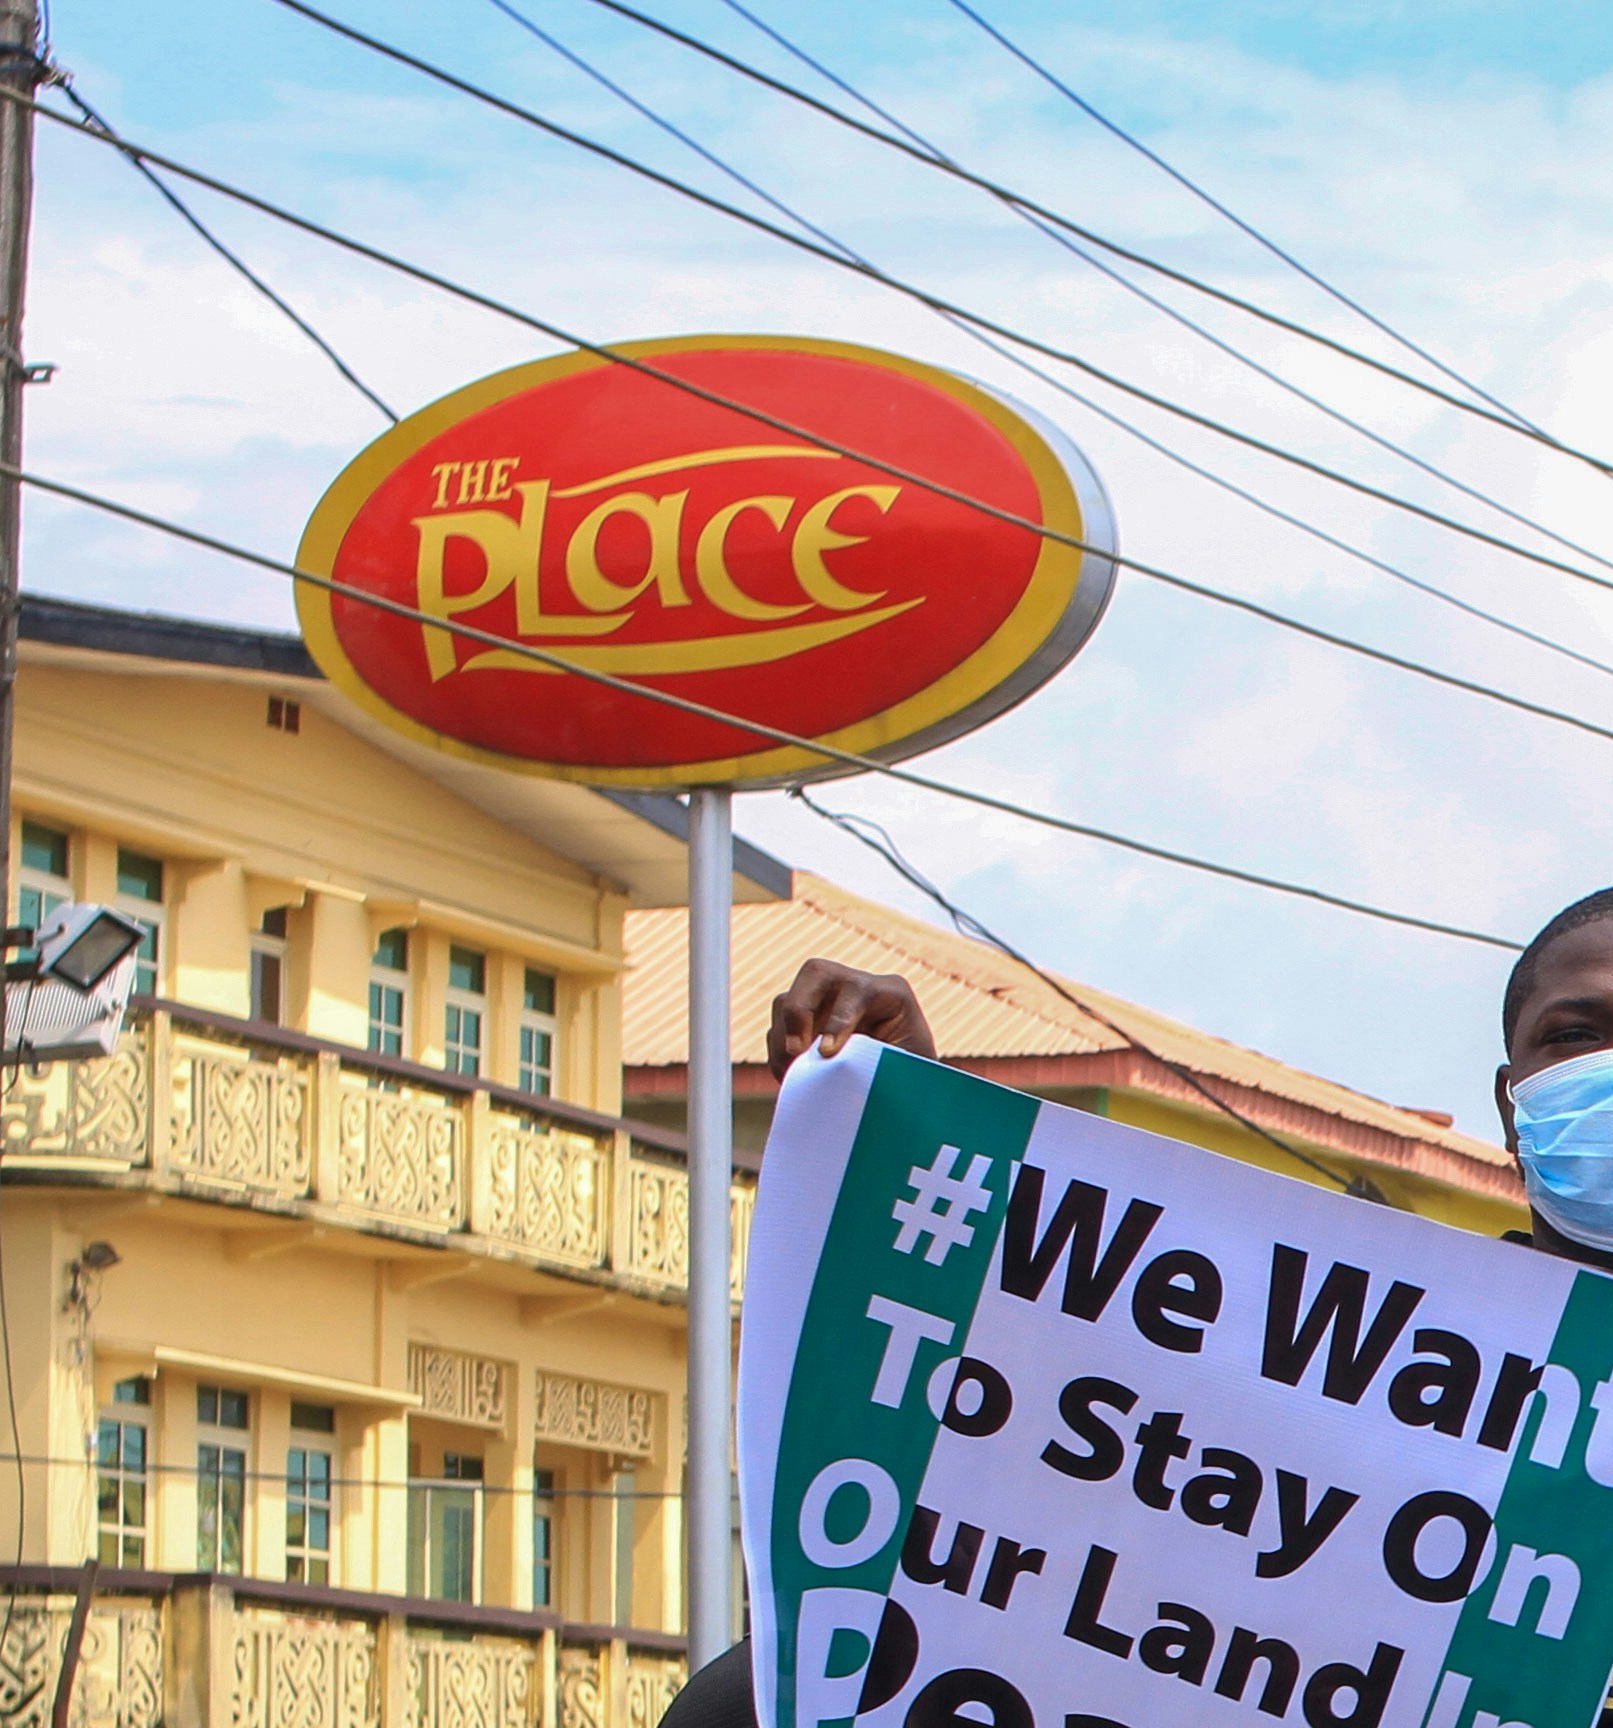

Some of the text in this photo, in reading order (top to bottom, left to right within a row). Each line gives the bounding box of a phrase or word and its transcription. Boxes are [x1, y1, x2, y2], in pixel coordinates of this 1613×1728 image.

[431, 456, 521, 509] THE
[890, 1143, 1222, 1354] #We
[799, 1457, 1045, 1613] Our
[863, 1294, 1583, 1641] To Stay On
